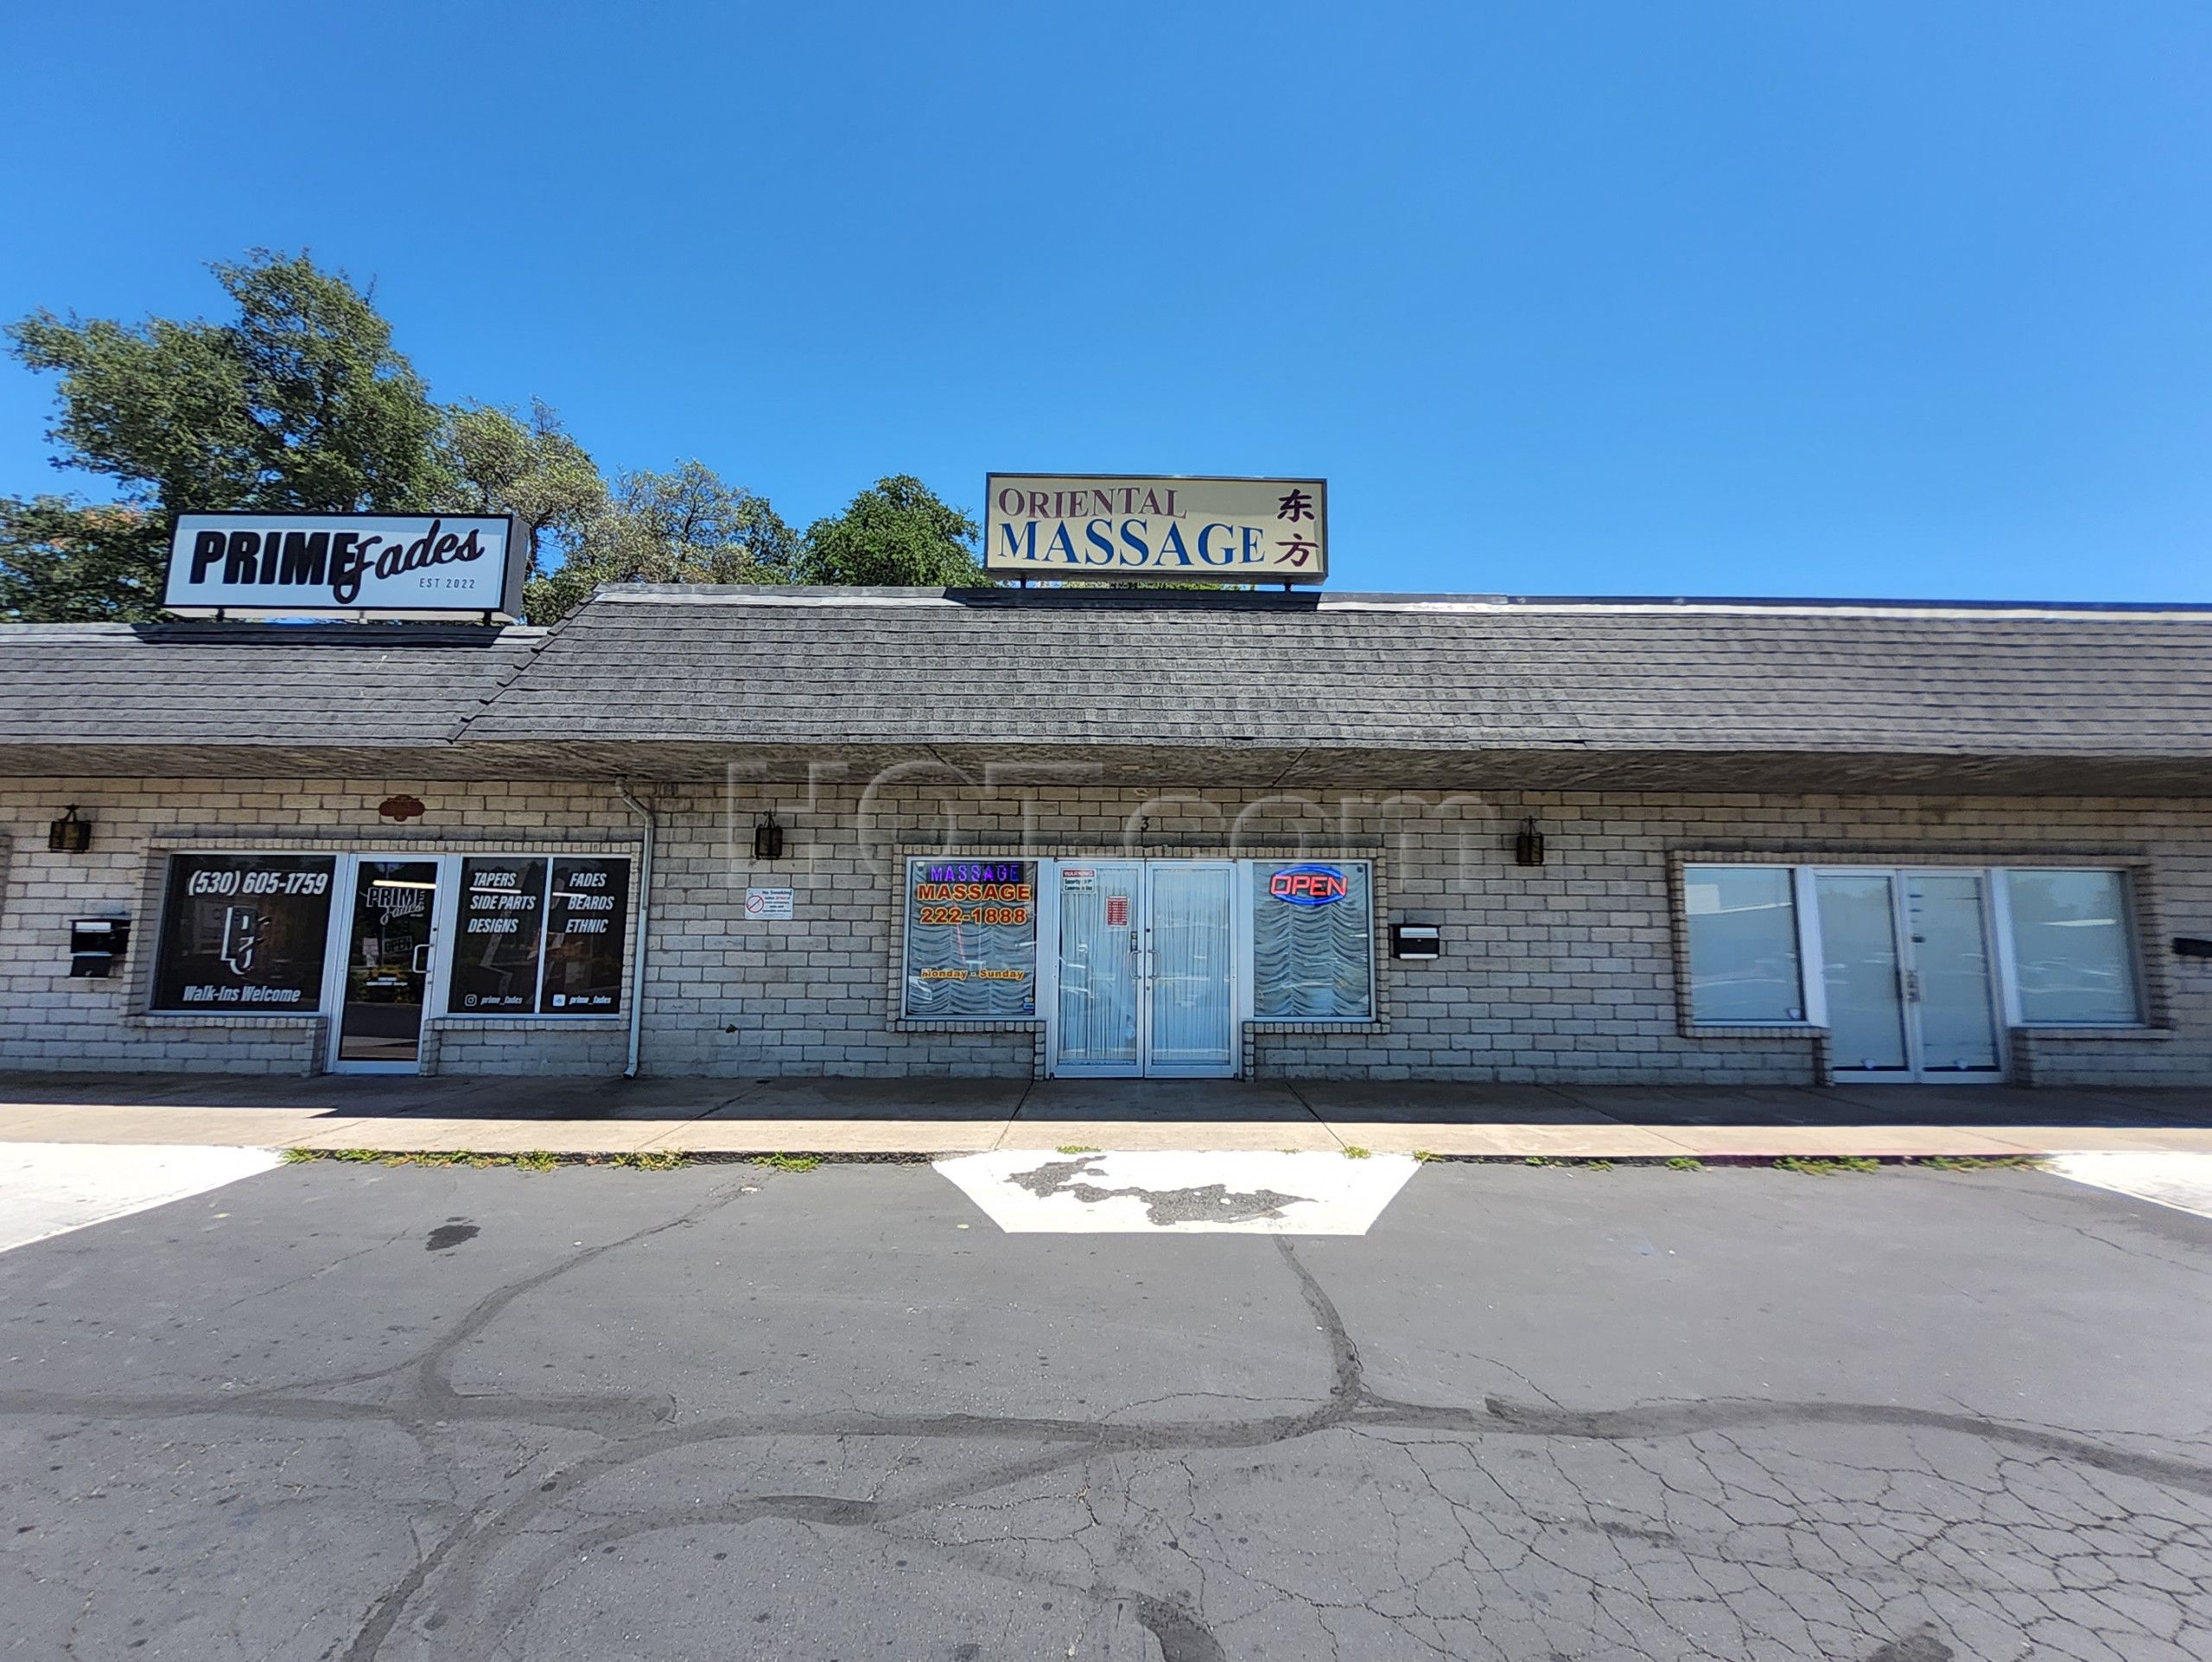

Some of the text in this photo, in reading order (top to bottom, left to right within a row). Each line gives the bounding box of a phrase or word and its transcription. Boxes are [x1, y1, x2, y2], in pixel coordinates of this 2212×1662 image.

[997, 487, 1188, 519] ORIENTAL
[997, 518, 1266, 567] MASSAGE
[188, 531, 360, 586] PRIME
[419, 577, 475, 589] EST 2022
[473, 872, 517, 888] TAPERS
[569, 872, 607, 888] FADES
[930, 864, 1020, 882] MASSAGE
[188, 869, 328, 896] (530) 605-1759
[1269, 874, 1347, 896] OPEN
[917, 883, 1033, 902] MASSAGE
[469, 895, 537, 910] SIDE PARTS
[567, 895, 615, 910] BEARDS
[467, 918, 518, 933] DESIGNS
[919, 907, 1028, 926] 222-1888
[565, 919, 609, 933] ETHNIC
[920, 968, 969, 981] Monday
[978, 968, 1025, 981] Sunday
[182, 984, 302, 1003] Walk-Ins Welcome
